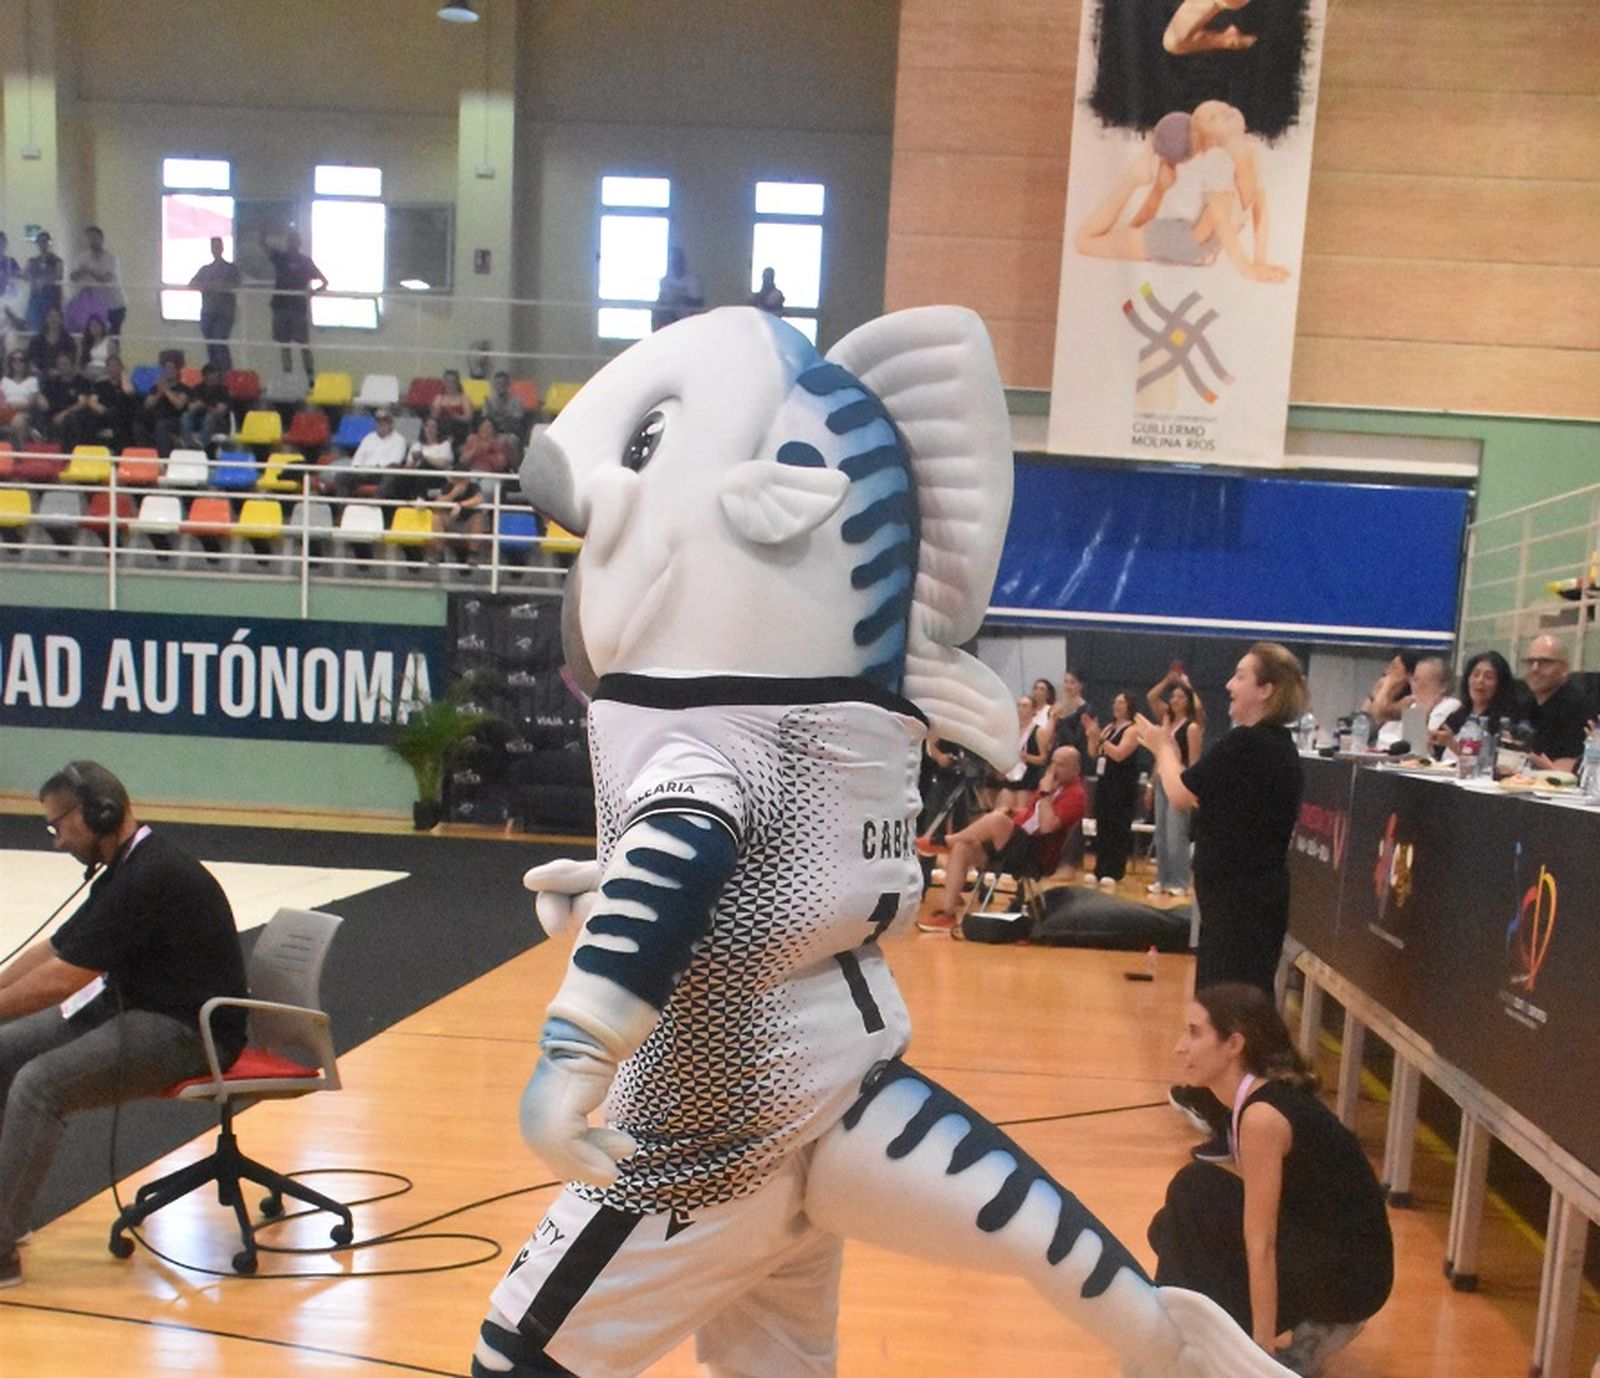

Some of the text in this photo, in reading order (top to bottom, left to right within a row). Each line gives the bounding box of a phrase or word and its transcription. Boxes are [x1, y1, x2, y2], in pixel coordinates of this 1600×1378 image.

[1131, 436, 1182, 449] MOLINA
[1132, 421, 1206, 437] GUILLERMO
[0, 628, 432, 725] AD AUTÓNOMA
[862, 819, 915, 860] CABA
